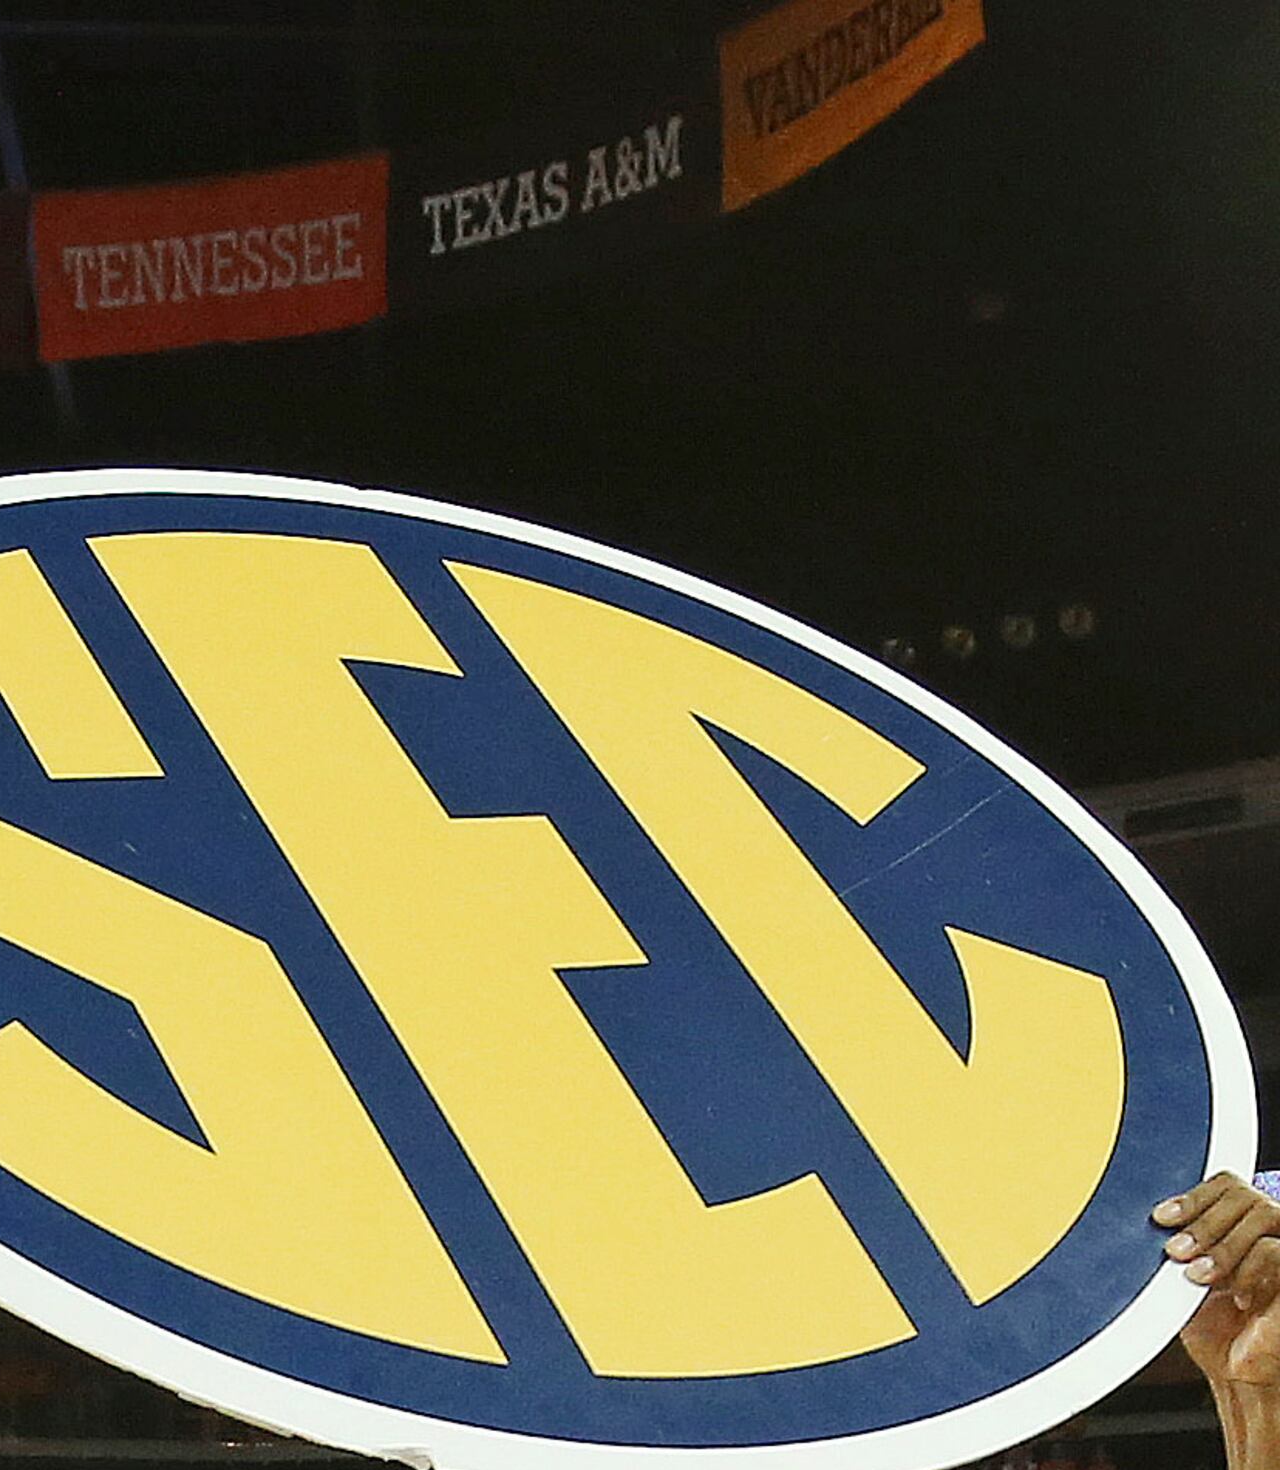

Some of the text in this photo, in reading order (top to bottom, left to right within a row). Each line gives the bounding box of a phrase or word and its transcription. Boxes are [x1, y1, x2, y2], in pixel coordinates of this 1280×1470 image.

[422, 115, 685, 256] TEXAS A&M
[61, 213, 364, 313] TENNESSEE
